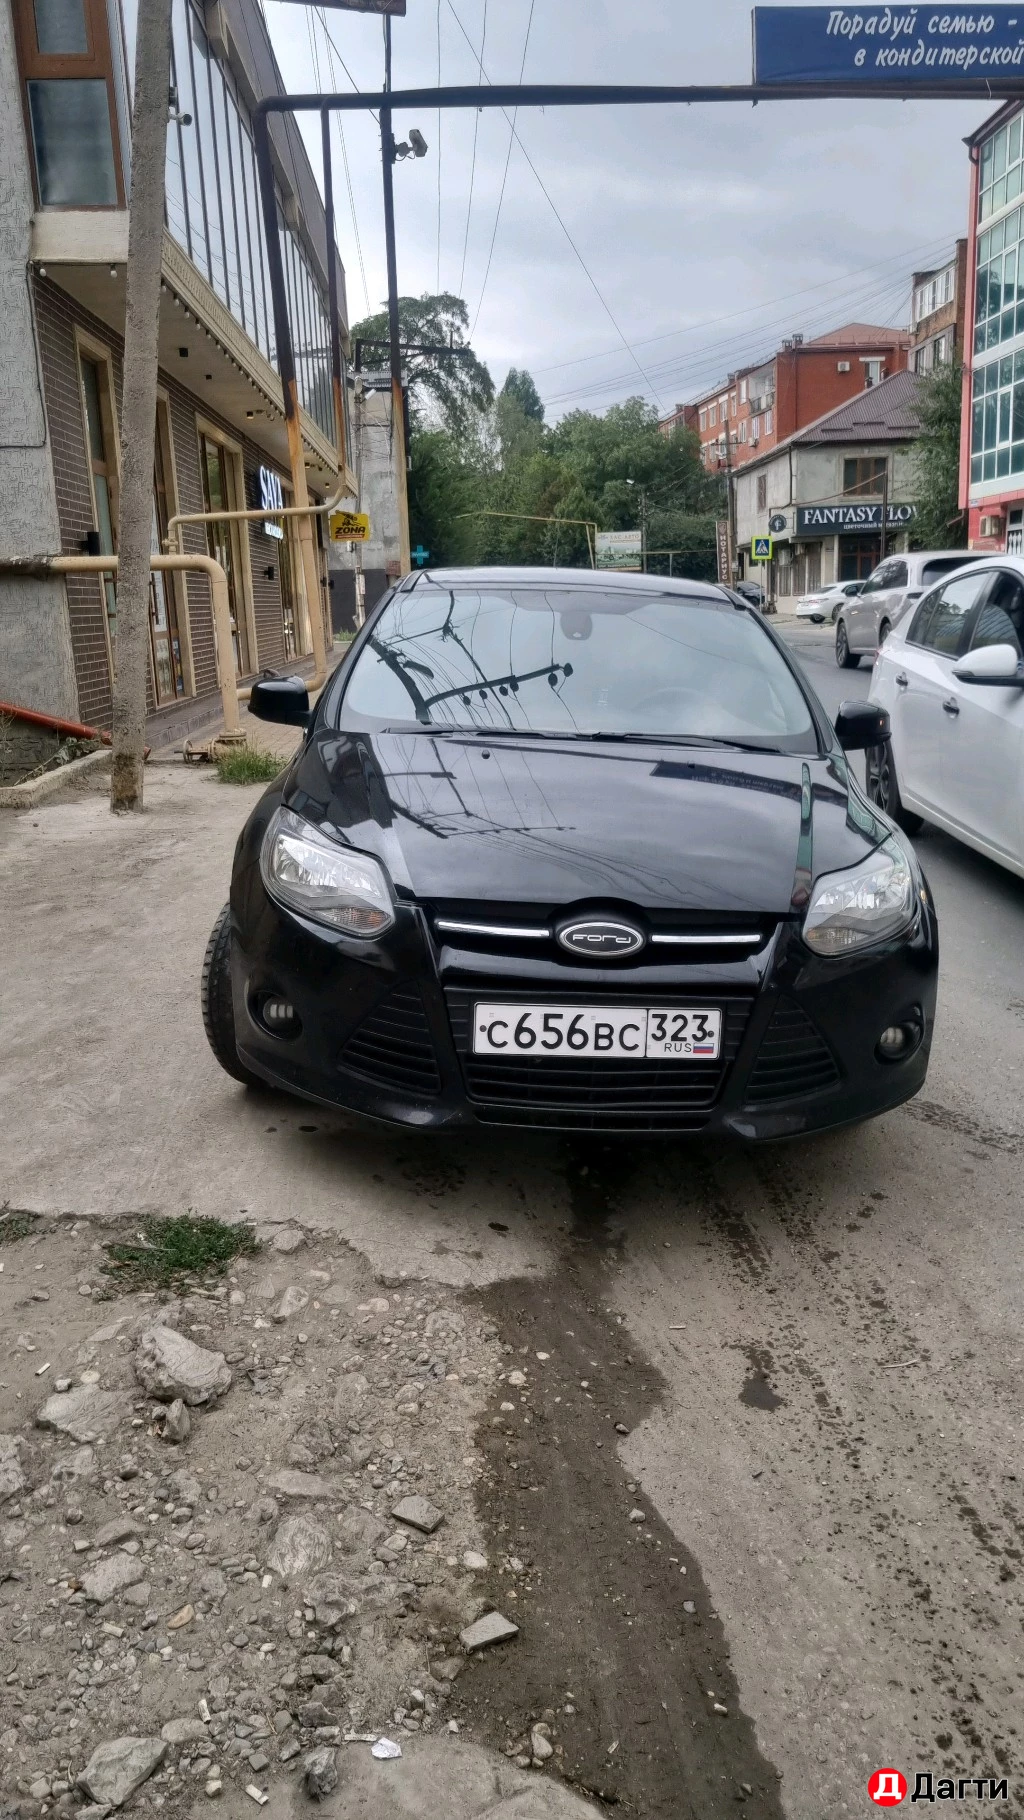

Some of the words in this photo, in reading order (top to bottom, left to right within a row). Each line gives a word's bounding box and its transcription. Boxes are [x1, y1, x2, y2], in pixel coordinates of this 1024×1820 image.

[826, 8, 918, 40] Порадуй
[927, 14, 994, 34] семью
[853, 48, 865, 67] в
[875, 38, 1024, 70] кондитерской
[335, 526, 366, 535] ZONA
[803, 507, 878, 525] FANTASY
[720, 535, 728, 580] НОТАРИУС
[651, 1013, 709, 1042] 323
[664, 1042, 692, 1053] RUS
